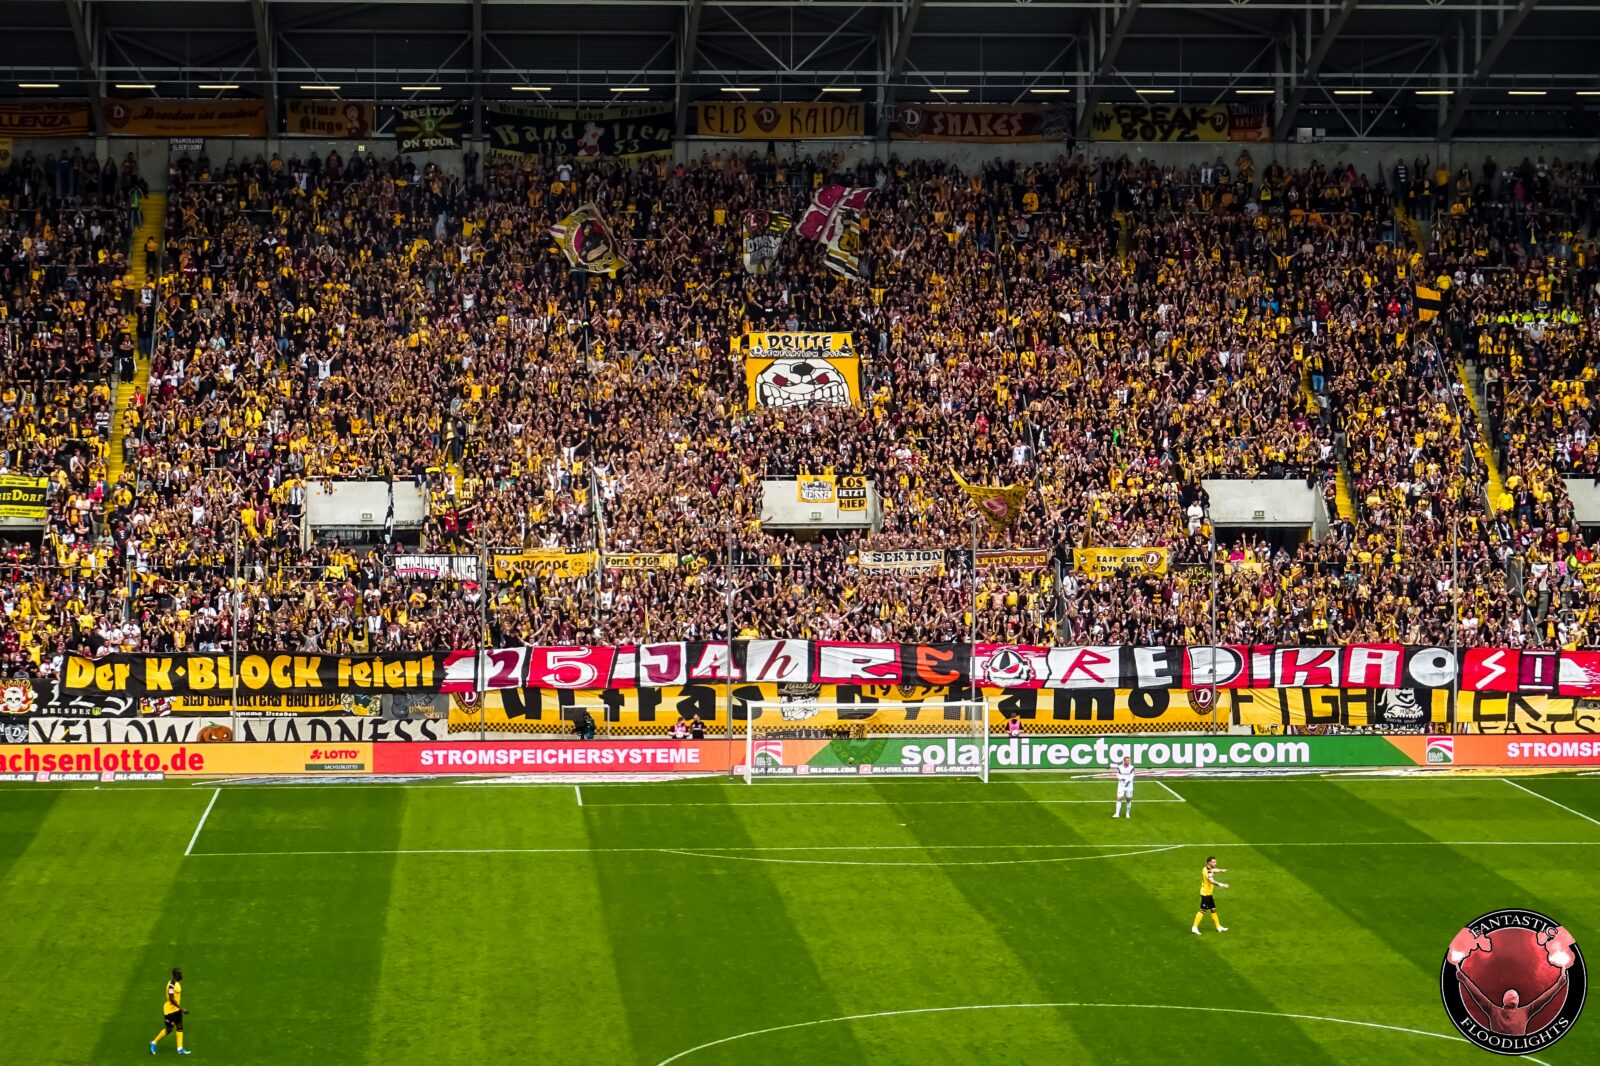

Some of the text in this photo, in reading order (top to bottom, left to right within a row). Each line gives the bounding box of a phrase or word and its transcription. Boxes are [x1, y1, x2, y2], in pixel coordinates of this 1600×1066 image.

[290, 100, 337, 116] Crime
[402, 105, 455, 121] FREITAL
[1113, 105, 1207, 125] FREAK
[704, 105, 746, 133] ELB
[790, 105, 859, 134] KAIDA
[932, 112, 1022, 136] SNAKES
[1121, 122, 1199, 141] BOYZ
[402, 137, 455, 149] ON TOUR
[768, 335, 831, 349] DRITTE
[840, 478, 863, 488] LOS
[838, 489, 865, 497] JETZT
[839, 499, 866, 509] HIER
[872, 551, 942, 563] SEKTION
[975, 556, 1031, 566] AKTIVIST
[1096, 555, 1145, 563] EAST CREW
[512, 560, 569, 571] BRIGADE
[65, 656, 131, 691] Der
[487, 646, 598, 688] 25
[243, 718, 441, 742] MADNESS
[324, 750, 358, 760] LOTTO
[420, 748, 700, 765] STROMSPEICHERSYSTEME
[901, 738, 1310, 767] solardirectgroup.com
